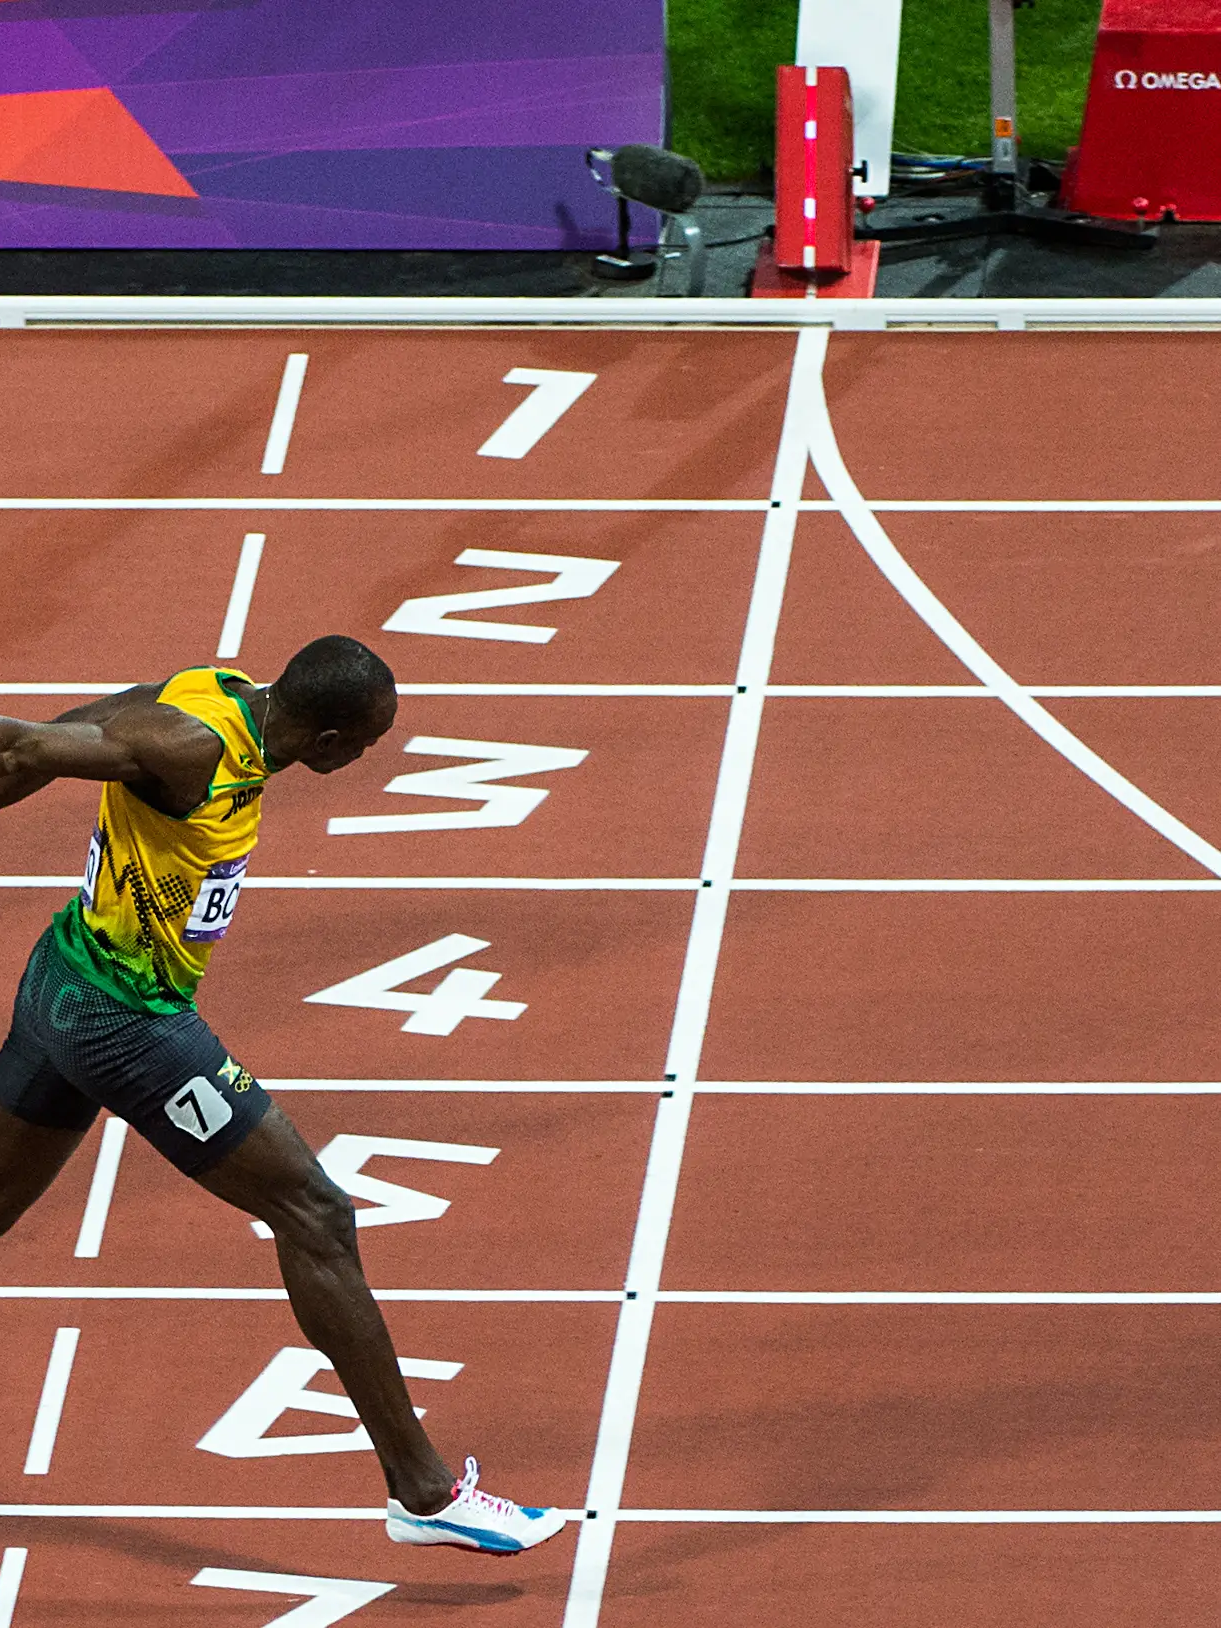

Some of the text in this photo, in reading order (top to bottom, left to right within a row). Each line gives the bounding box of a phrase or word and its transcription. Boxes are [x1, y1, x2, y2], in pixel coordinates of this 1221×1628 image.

[1141, 72, 1221, 91] OMEGA
[476, 367, 598, 460] 1
[381, 548, 622, 645] 2
[327, 736, 591, 836] 3
[302, 933, 529, 1036] 4
[175, 1089, 209, 1134] 7
